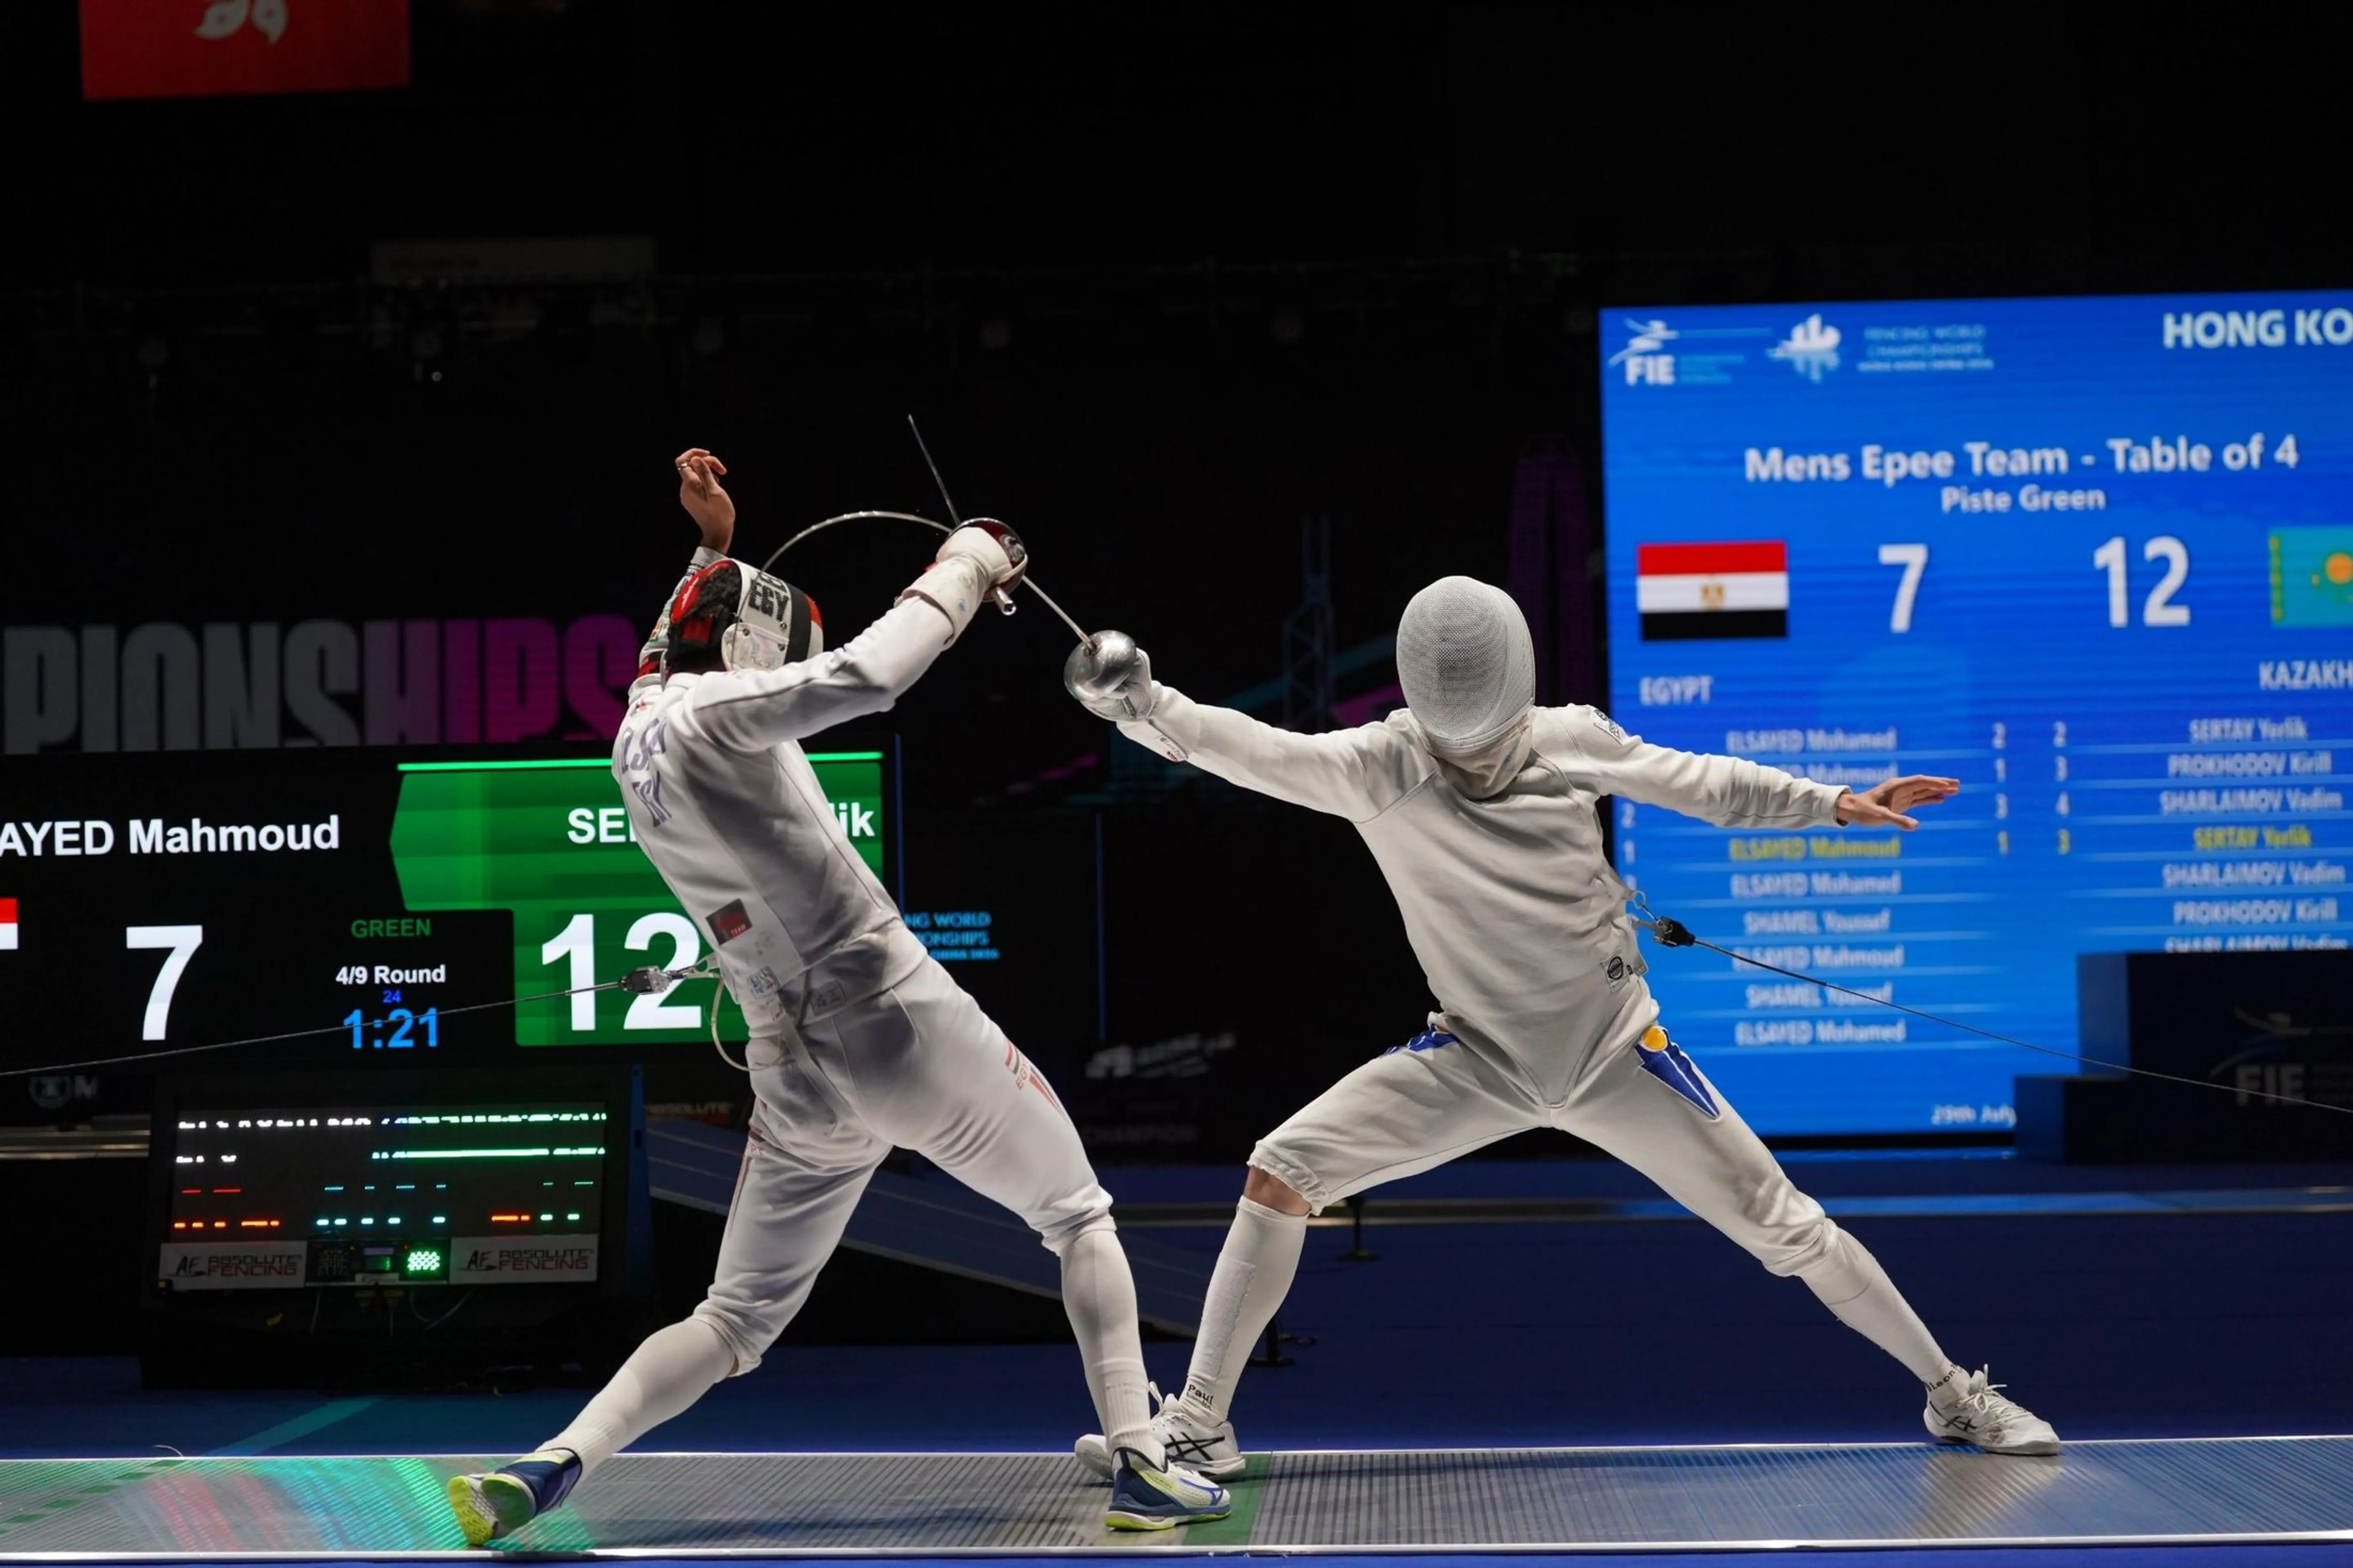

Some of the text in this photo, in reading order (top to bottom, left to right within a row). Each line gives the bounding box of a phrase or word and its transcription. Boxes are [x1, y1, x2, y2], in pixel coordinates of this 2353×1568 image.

[2163, 308, 2353, 349] HONG KO
[1625, 354, 1676, 386] FIE
[1744, 447, 1851, 482] Mens
[1862, 444, 1954, 487] Epee
[1964, 441, 2068, 476] Team
[2107, 436, 2211, 473] Table
[2222, 432, 2264, 470] of
[2274, 433, 2299, 469] 4
[1941, 484, 2105, 513] Piste Green
[1879, 544, 1927, 633] 7
[2094, 536, 2190, 628] 12
[748, 579, 789, 621] EGY
[2259, 659, 2353, 690] KAZAKH
[1639, 676, 1712, 706] EGYPT
[2053, 720, 2067, 747] 2
[0, 815, 339, 857] AYED Mahmoud
[567, 808, 636, 844] SE
[350, 918, 431, 938] GREEN
[933, 911, 992, 928] WORLD
[126, 925, 203, 1041] 7
[335, 964, 446, 985] 4/9 Round
[541, 912, 702, 1031] 12
[382, 989, 402, 1004] 24
[343, 1007, 438, 1049] 1:21
[2235, 1063, 2305, 1107] FIE
[208, 1253, 301, 1265] ABSOLUTE
[498, 1248, 591, 1260] ABSOLUTE
[498, 1258, 589, 1271] FENCING
[208, 1264, 297, 1277] FENCING
[1188, 1384, 1214, 1405] Paul
